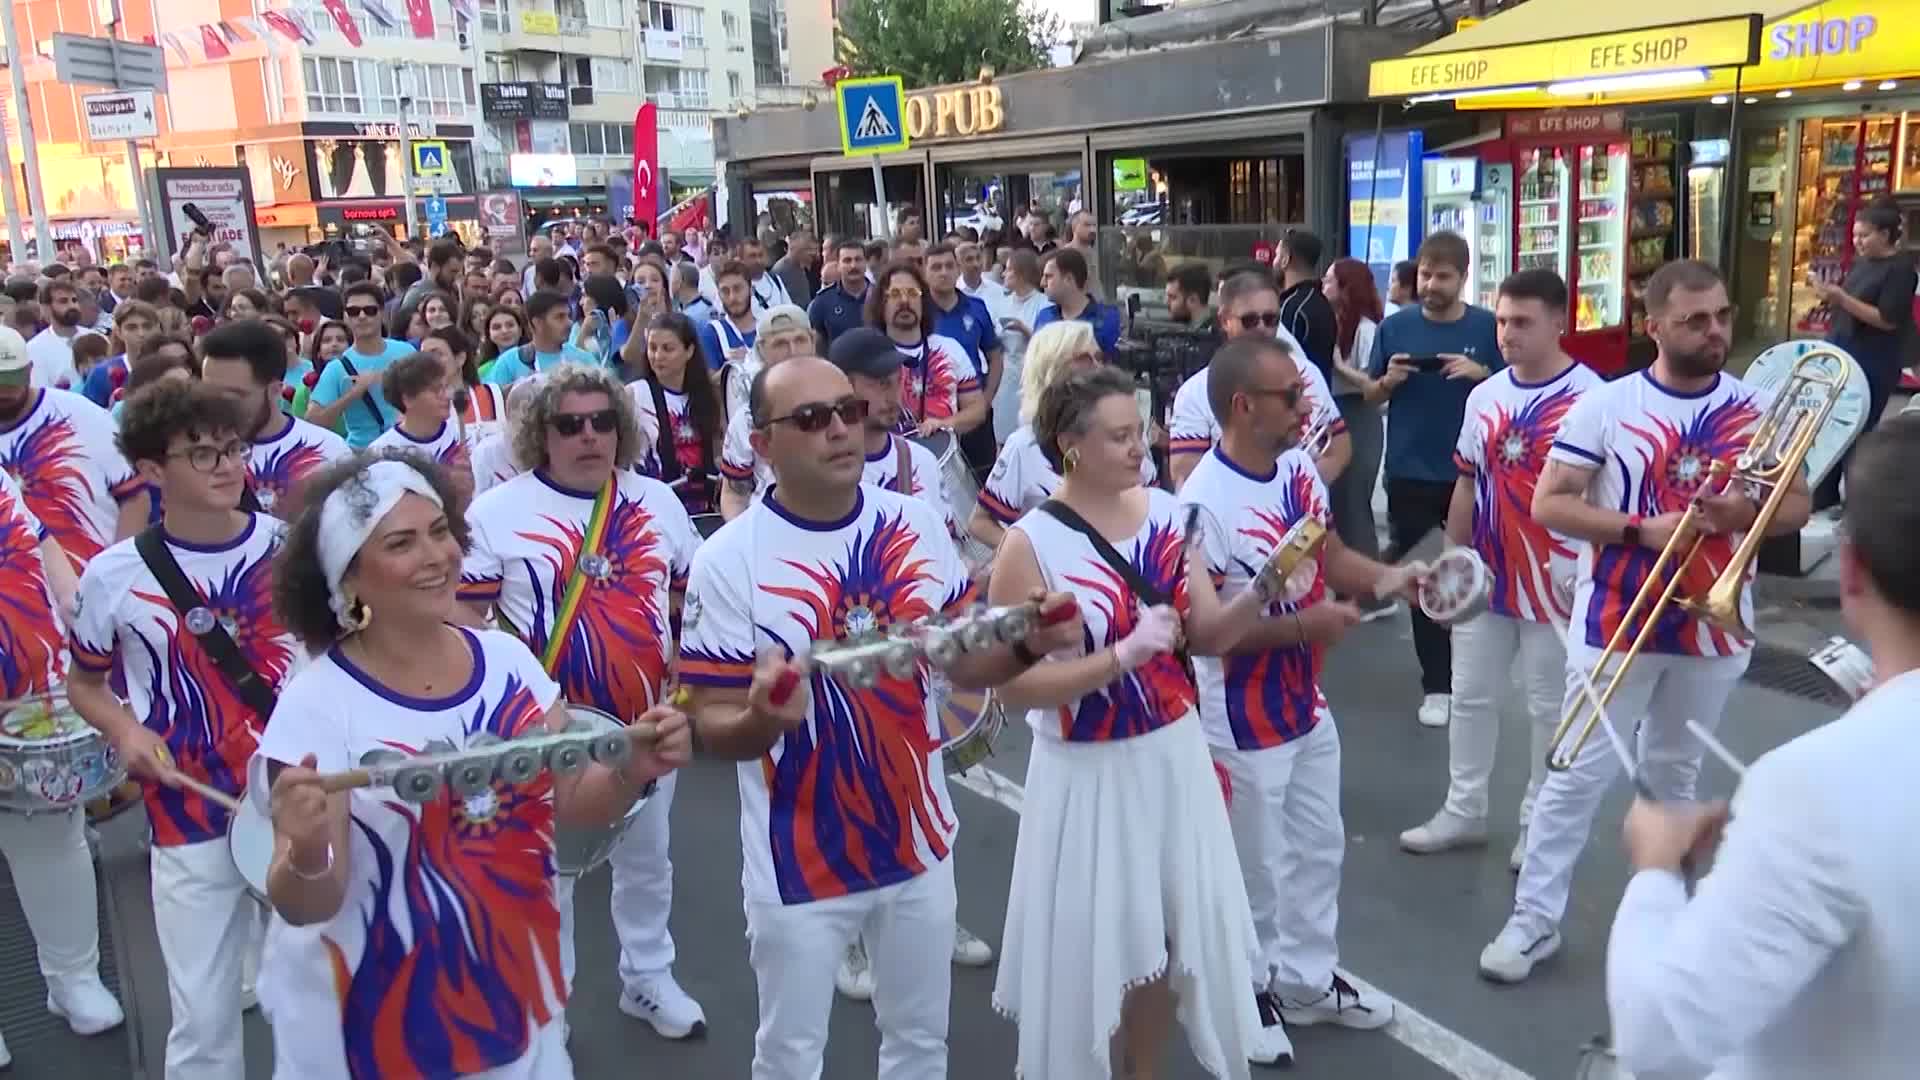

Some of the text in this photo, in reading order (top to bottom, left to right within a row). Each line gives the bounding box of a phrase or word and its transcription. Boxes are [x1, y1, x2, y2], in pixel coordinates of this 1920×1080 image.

[1770, 15, 1877, 59] SHOP
[1590, 37, 1688, 69] EFE SHOP
[1411, 60, 1488, 87] EFE SHOP
[934, 86, 1003, 137] PUB
[1538, 117, 1563, 132] EFE
[1565, 115, 1600, 131] SHOP
[176, 182, 235, 194] hepsiburada
